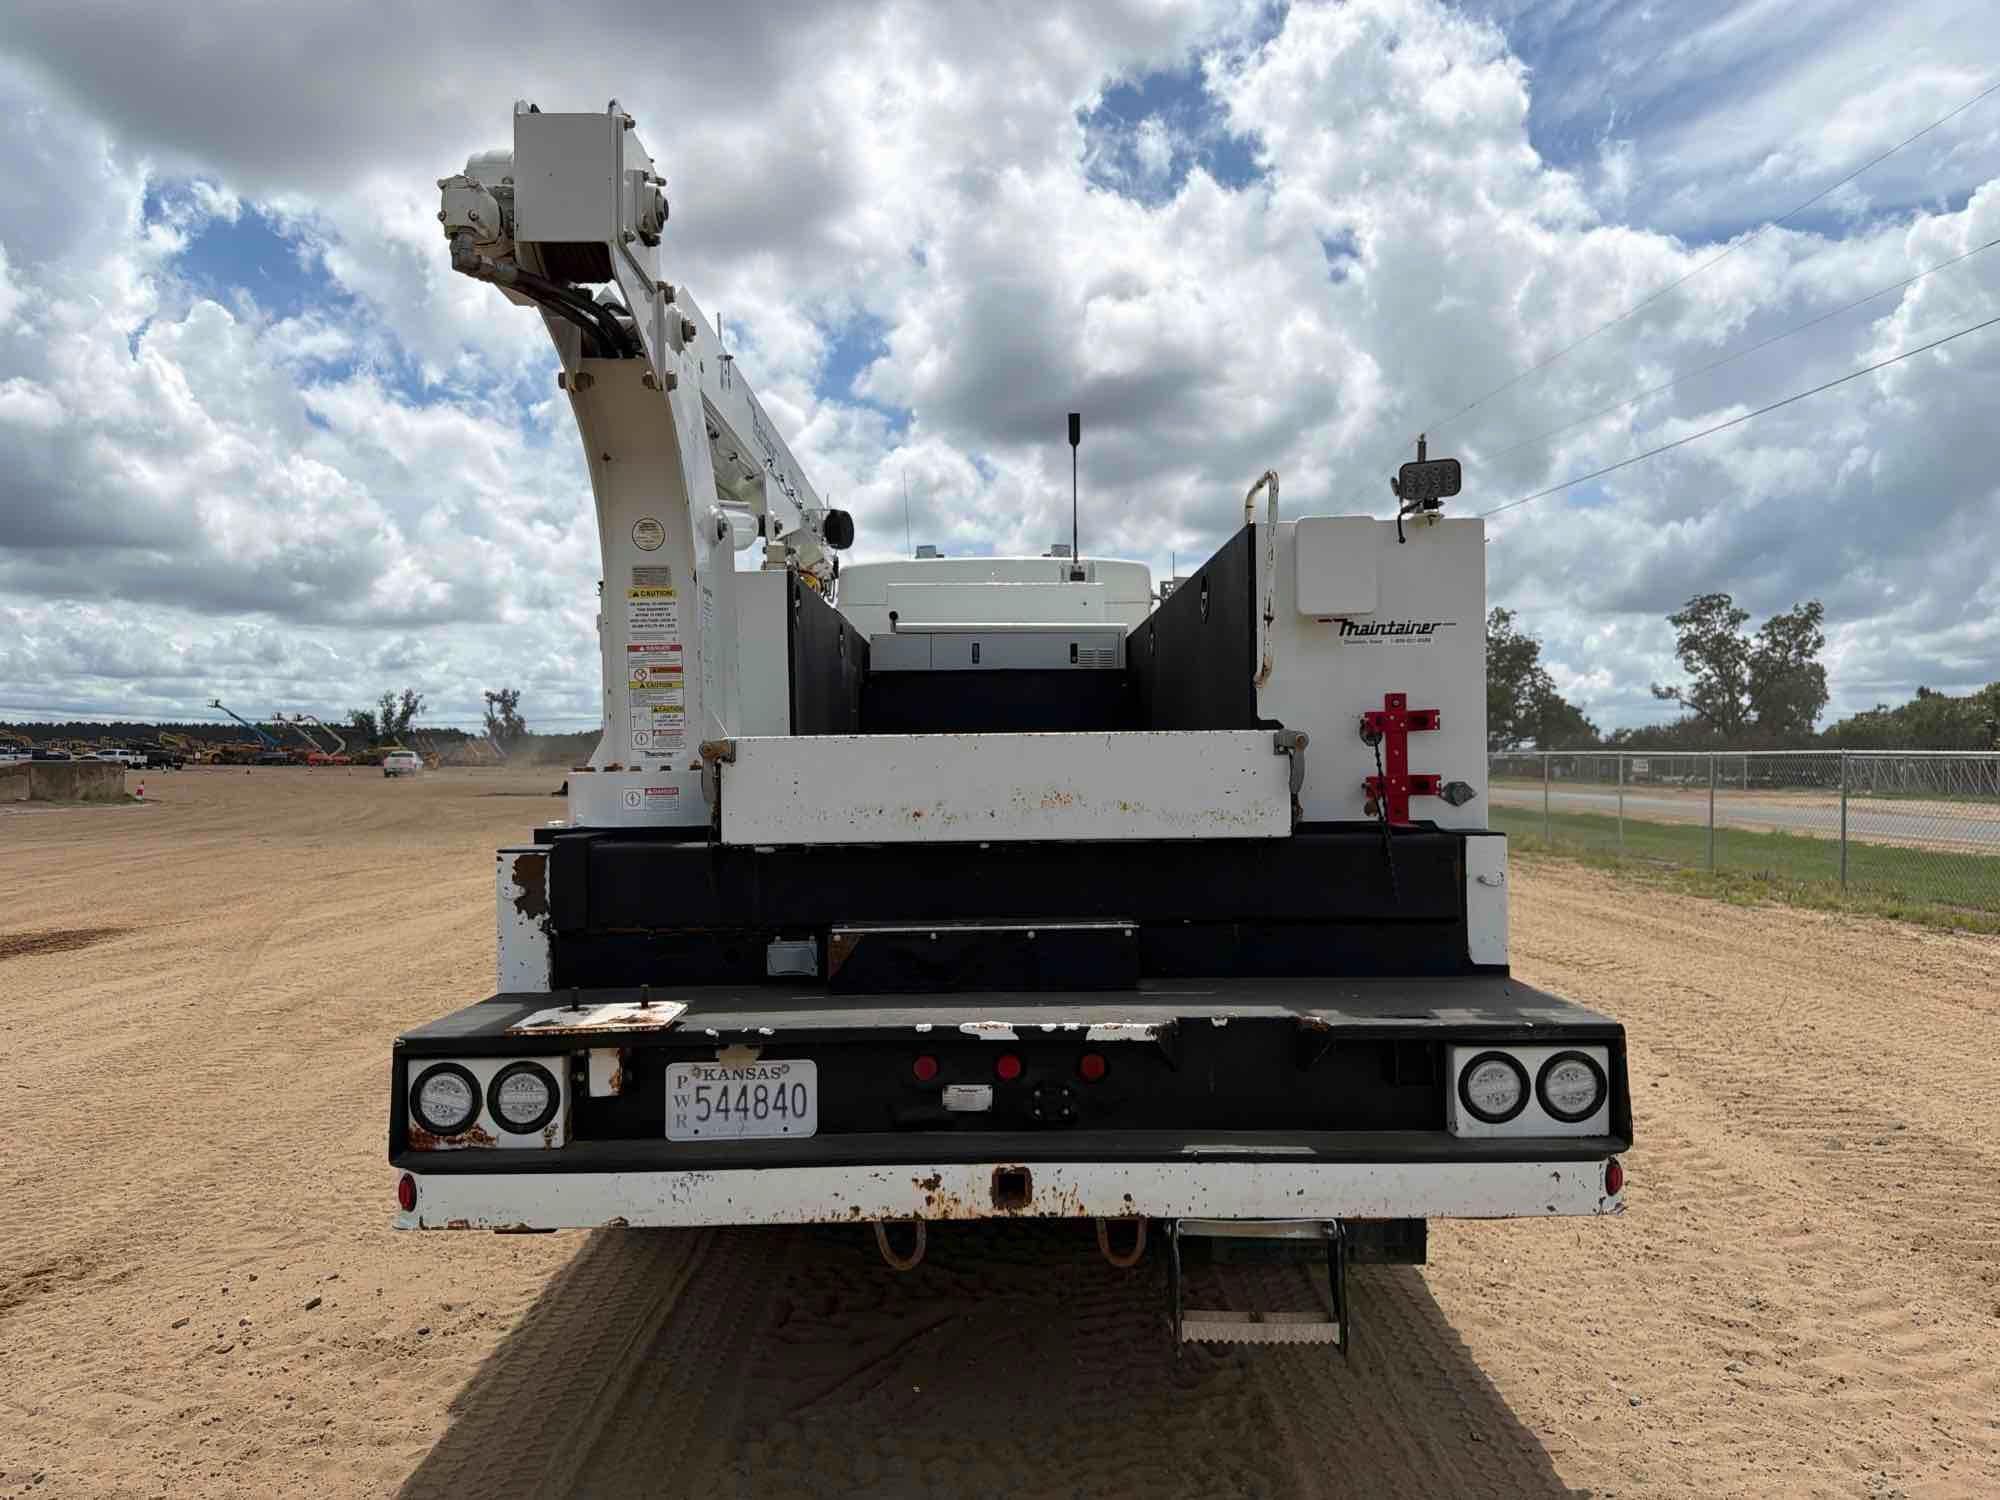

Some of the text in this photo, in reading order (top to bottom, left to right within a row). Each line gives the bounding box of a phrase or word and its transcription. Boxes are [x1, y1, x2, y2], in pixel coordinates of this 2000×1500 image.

[640, 590, 673, 598] CAUTION
[704, 1066, 781, 1080] KANSAS
[695, 1083, 807, 1122] 544840
